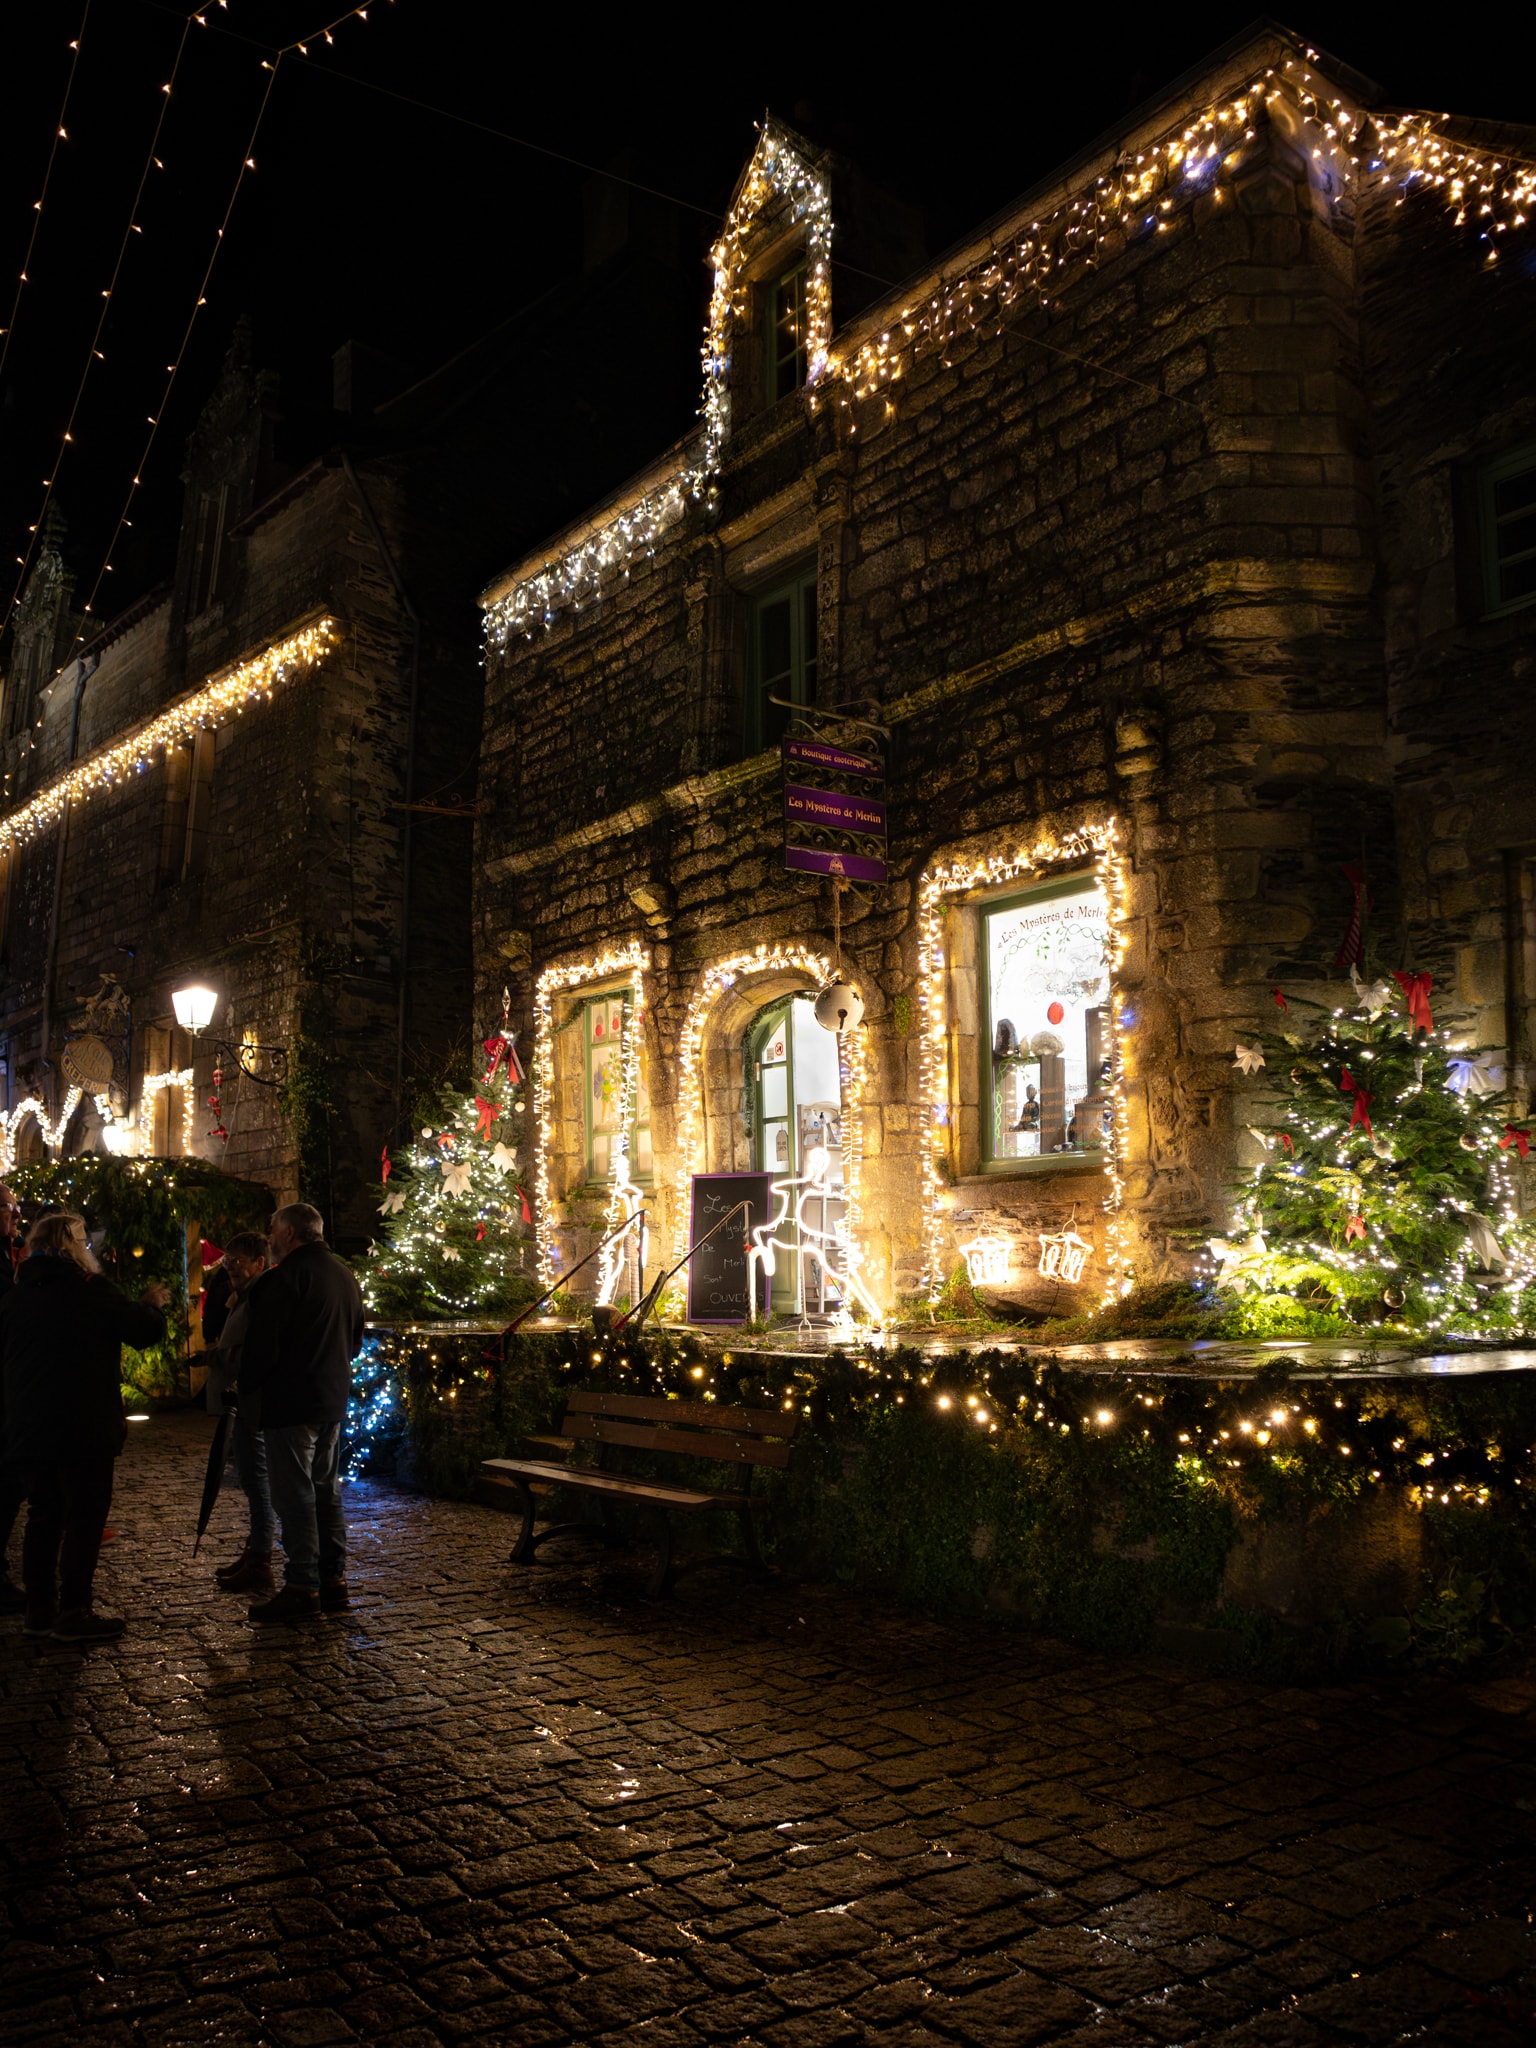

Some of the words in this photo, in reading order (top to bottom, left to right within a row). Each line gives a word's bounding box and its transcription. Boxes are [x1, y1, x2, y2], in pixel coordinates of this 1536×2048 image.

[801, 748, 832, 762] Boutique
[788, 796, 803, 809] Les
[805, 799, 841, 815] Mystères
[843, 807, 853, 818] de
[855, 809, 881, 824] Merlin
[1001, 928, 1018, 944] Les
[1019, 911, 1061, 932] Mystères
[1063, 907, 1074, 919] de
[1078, 905, 1106, 920] Merli
[703, 1193, 732, 1214] Les
[701, 1243, 716, 1254] De
[723, 1257, 745, 1270] Merli
[703, 1274, 725, 1284] Sont
[709, 1292, 764, 1305] OUVES
